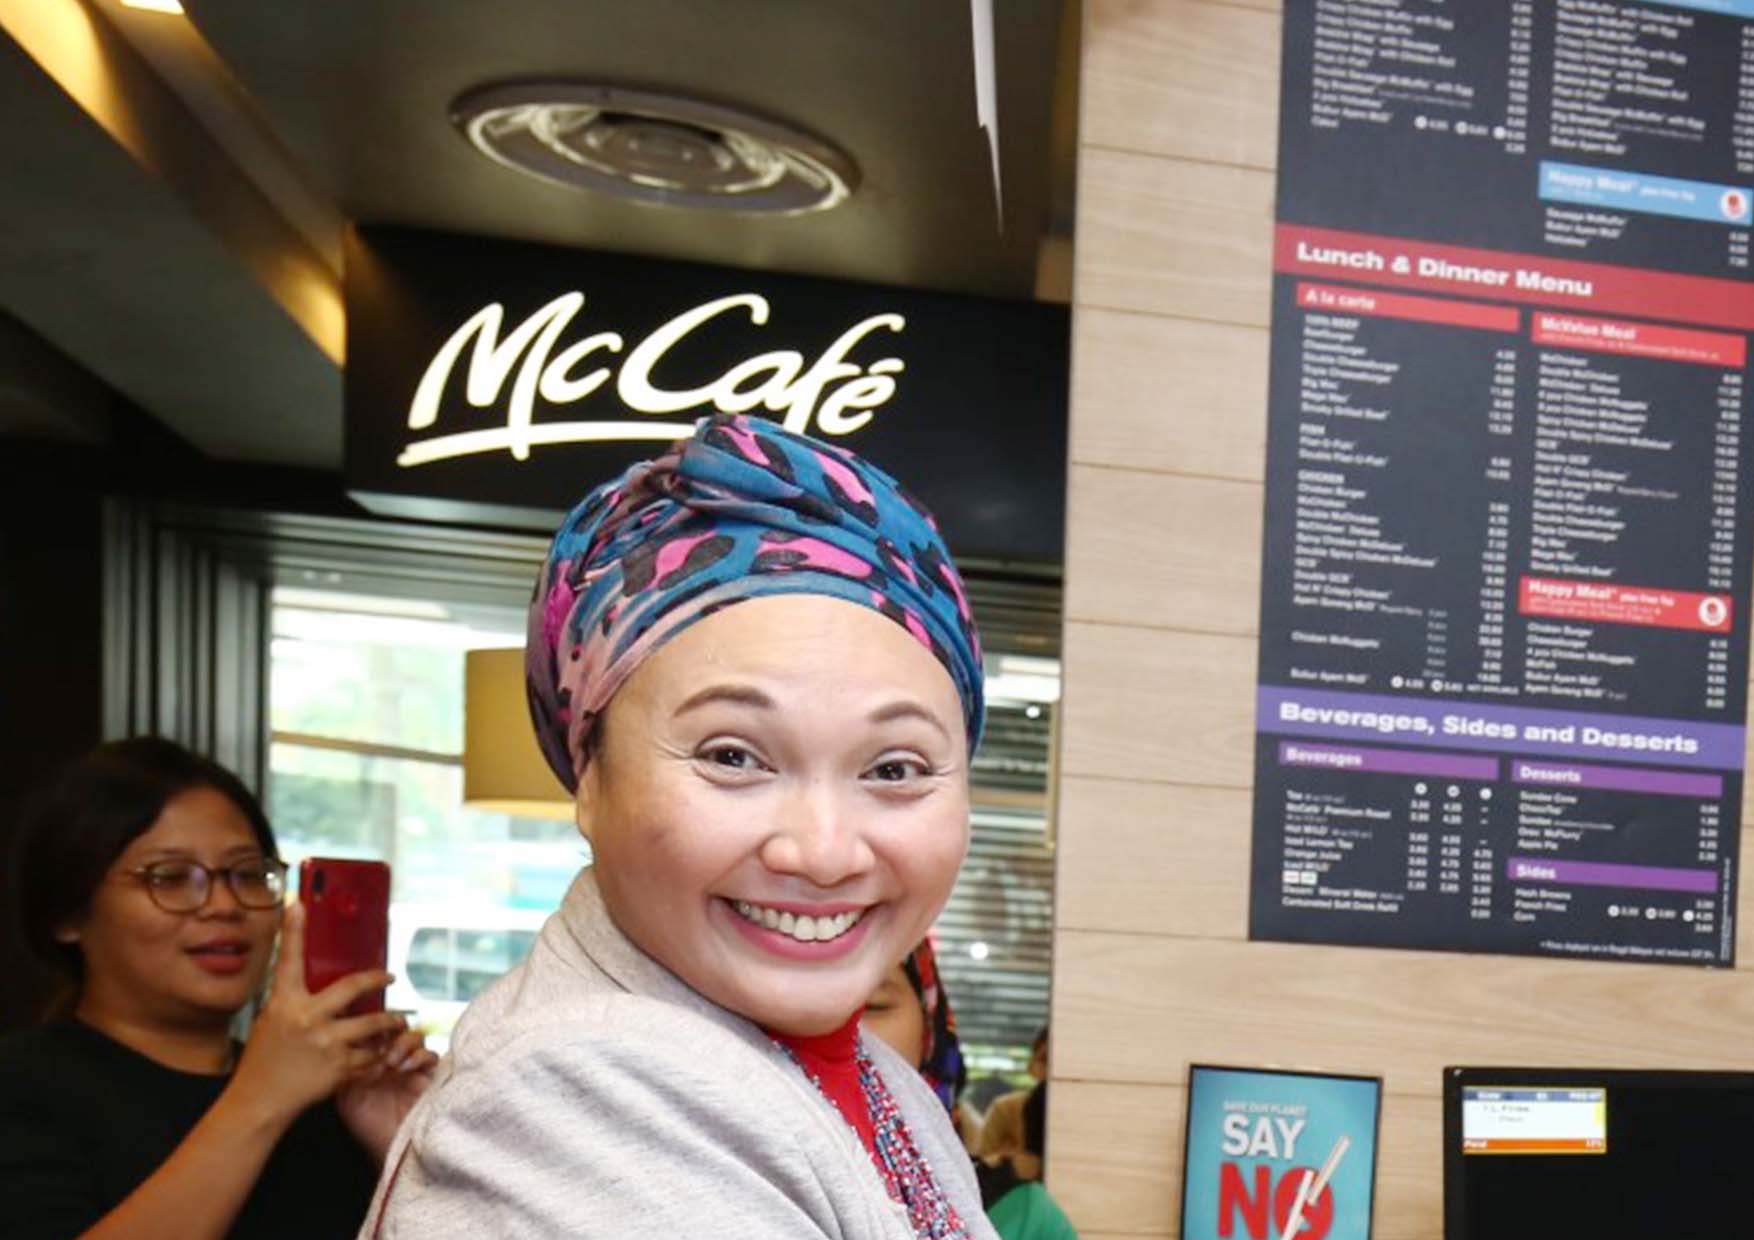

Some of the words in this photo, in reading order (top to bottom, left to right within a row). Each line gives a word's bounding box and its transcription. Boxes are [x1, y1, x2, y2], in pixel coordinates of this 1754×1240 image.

[1297, 243, 1383, 269] Lunch
[1391, 256, 1409, 273] &
[1419, 258, 1507, 285] Dinner
[1516, 270, 1591, 295] Menu
[1306, 289, 1317, 302] A
[1321, 291, 1334, 305] la
[1338, 295, 1374, 310] carte
[402, 291, 906, 466] McCafé
[1280, 703, 1432, 733] Beverages,
[1443, 716, 1515, 738] Sides
[1524, 726, 1574, 743] and
[1582, 728, 1696, 753] Desserts
[1286, 747, 1361, 766] Beverages
[1520, 765, 1580, 782] Desserts
[1516, 863, 1555, 879] Sides
[1222, 1113, 1306, 1159] SAY
